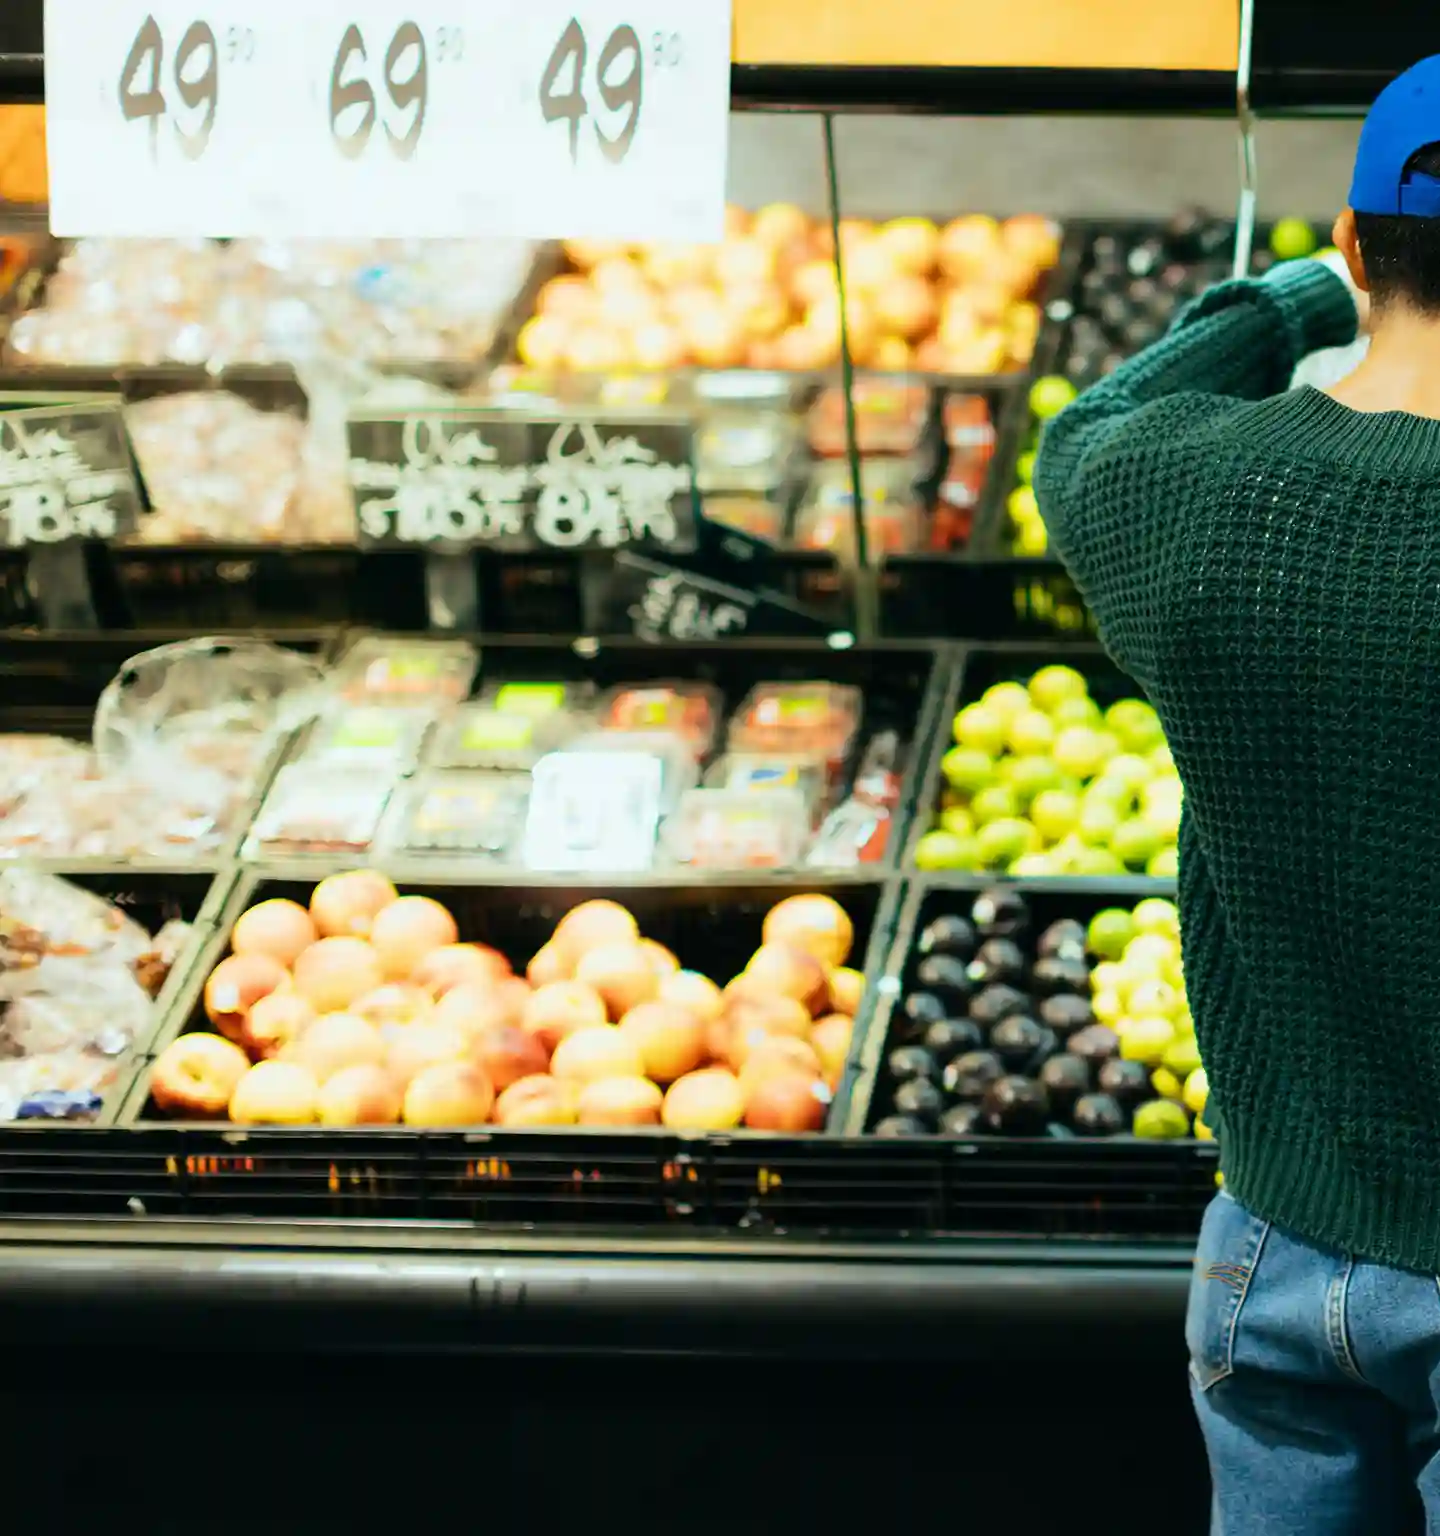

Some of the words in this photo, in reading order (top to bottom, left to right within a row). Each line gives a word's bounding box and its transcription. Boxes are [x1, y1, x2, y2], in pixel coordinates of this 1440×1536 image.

[119, 13, 219, 163] 49
[330, 20, 428, 161] 69
[539, 15, 643, 165] 49
